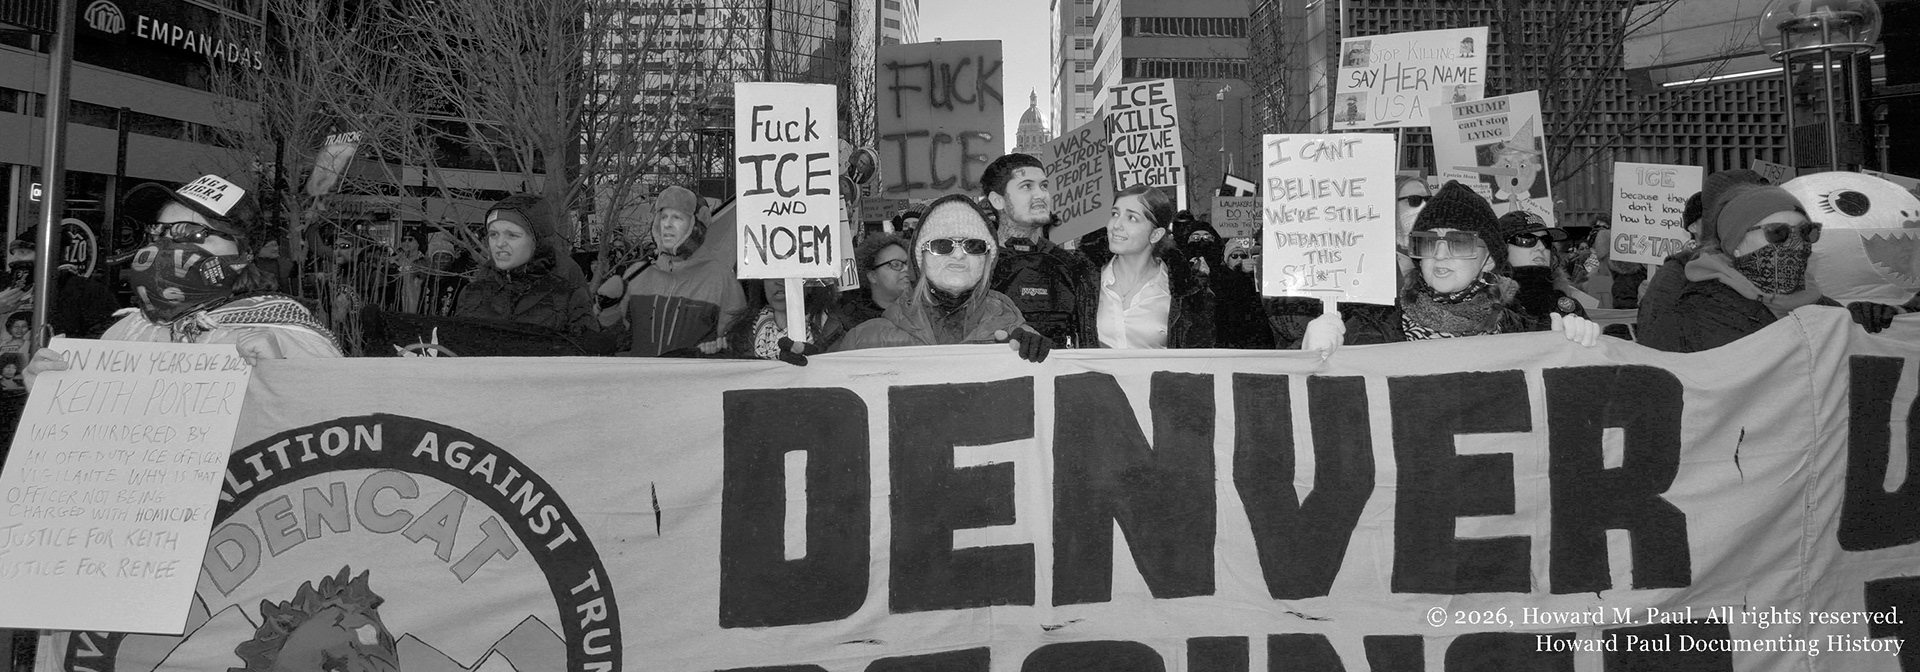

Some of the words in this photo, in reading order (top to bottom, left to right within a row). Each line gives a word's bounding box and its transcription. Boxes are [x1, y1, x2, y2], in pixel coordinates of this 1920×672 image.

[137, 14, 262, 70] EMPANADAS
[1348, 69, 1379, 89] SAY
[1381, 62, 1429, 95] HER
[1432, 65, 1478, 85] NAME
[1110, 82, 1167, 110] ICE
[1374, 95, 1423, 120] USA
[1111, 104, 1176, 133] KILLS
[1456, 100, 1506, 116] TRUMP
[751, 105, 819, 142] Fuck
[1458, 118, 1484, 130] can't
[1485, 115, 1508, 125] stop
[1467, 128, 1502, 140] LYING
[1053, 129, 1091, 158] WAR
[1114, 133, 1149, 157] CUZ
[1150, 129, 1174, 150] WE
[1267, 137, 1291, 168] I
[881, 129, 992, 193] ICE
[1045, 138, 1106, 178] DESTROYS
[1124, 151, 1175, 170] WONT
[738, 152, 831, 197] ICE
[1056, 156, 1102, 191] PEOPLE
[1118, 167, 1180, 189] FIGHT
[1636, 166, 1678, 188] ICE
[1763, 163, 1786, 180] FIRST
[1052, 176, 1103, 211] PLANET
[1267, 175, 1367, 202] BELIEVE
[1620, 188, 1658, 200] because
[763, 201, 807, 216] AND
[1227, 209, 1241, 217] DO
[1265, 203, 1320, 225] WE'RE
[1323, 205, 1380, 222] STILL
[1628, 201, 1652, 212] don't
[1619, 213, 1639, 223] how
[1644, 214, 1655, 224] to
[744, 224, 832, 265] NOEM
[1275, 229, 1363, 249] DEBATING
[1303, 250, 1342, 265] THIS
[96, 350, 140, 373] NEW
[149, 351, 192, 374] YEARS
[195, 352, 221, 371] EVE
[47, 378, 139, 415] KEITH
[143, 378, 237, 417] PORTER
[30, 423, 71, 443] WAS
[81, 423, 176, 443] MURDERED
[187, 426, 210, 443] BY
[24, 450, 47, 465] AN
[141, 449, 168, 463] ICE
[20, 468, 116, 483] VIGILANTE
[128, 469, 167, 485] WHY
[175, 470, 185, 483] IS
[194, 469, 219, 484] THAT
[7, 486, 79, 503] OFFICER
[83, 487, 110, 504] NOT
[117, 489, 165, 504] BEING
[220, 424, 383, 502] LITION
[413, 431, 577, 553] AGAINST
[720, 364, 1692, 628] DENVER
[9, 504, 85, 518] CHARGED
[93, 507, 129, 522] WITH
[135, 504, 213, 523] HOMICIDE?
[85, 527, 114, 549] FOR
[126, 530, 179, 550] KEITH
[201, 470, 519, 597] DENCAT
[77, 558, 107, 578] FOR
[118, 559, 181, 579] RENEE
